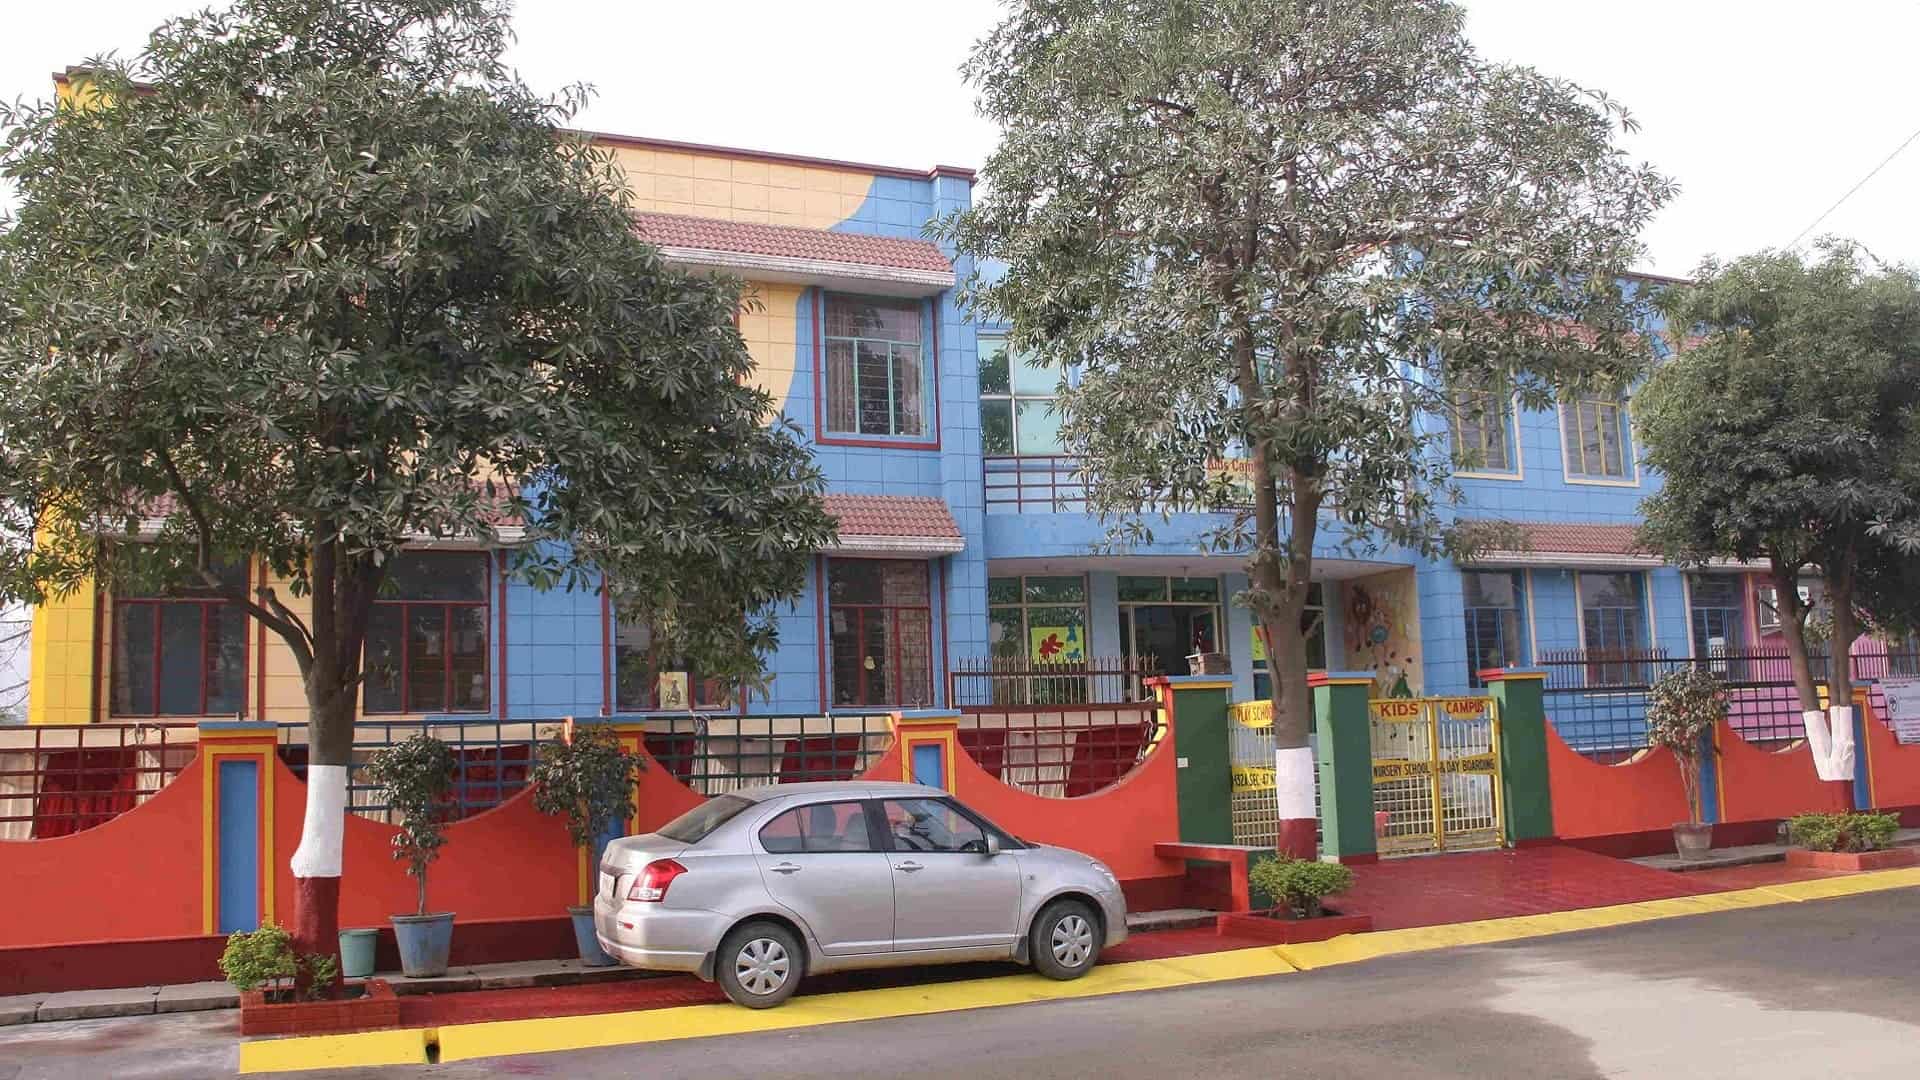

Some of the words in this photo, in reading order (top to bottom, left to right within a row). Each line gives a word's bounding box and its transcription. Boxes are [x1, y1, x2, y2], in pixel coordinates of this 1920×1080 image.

[1235, 705, 1251, 721] PLAY
[1380, 703, 1418, 717] KIDS
[1446, 701, 1484, 714] CAMPUS
[1373, 764, 1402, 777] NURSERY
[1403, 762, 1430, 776] SCHOOL
[1447, 760, 1460, 773] DAY
[1462, 759, 1495, 771] BOARDING
